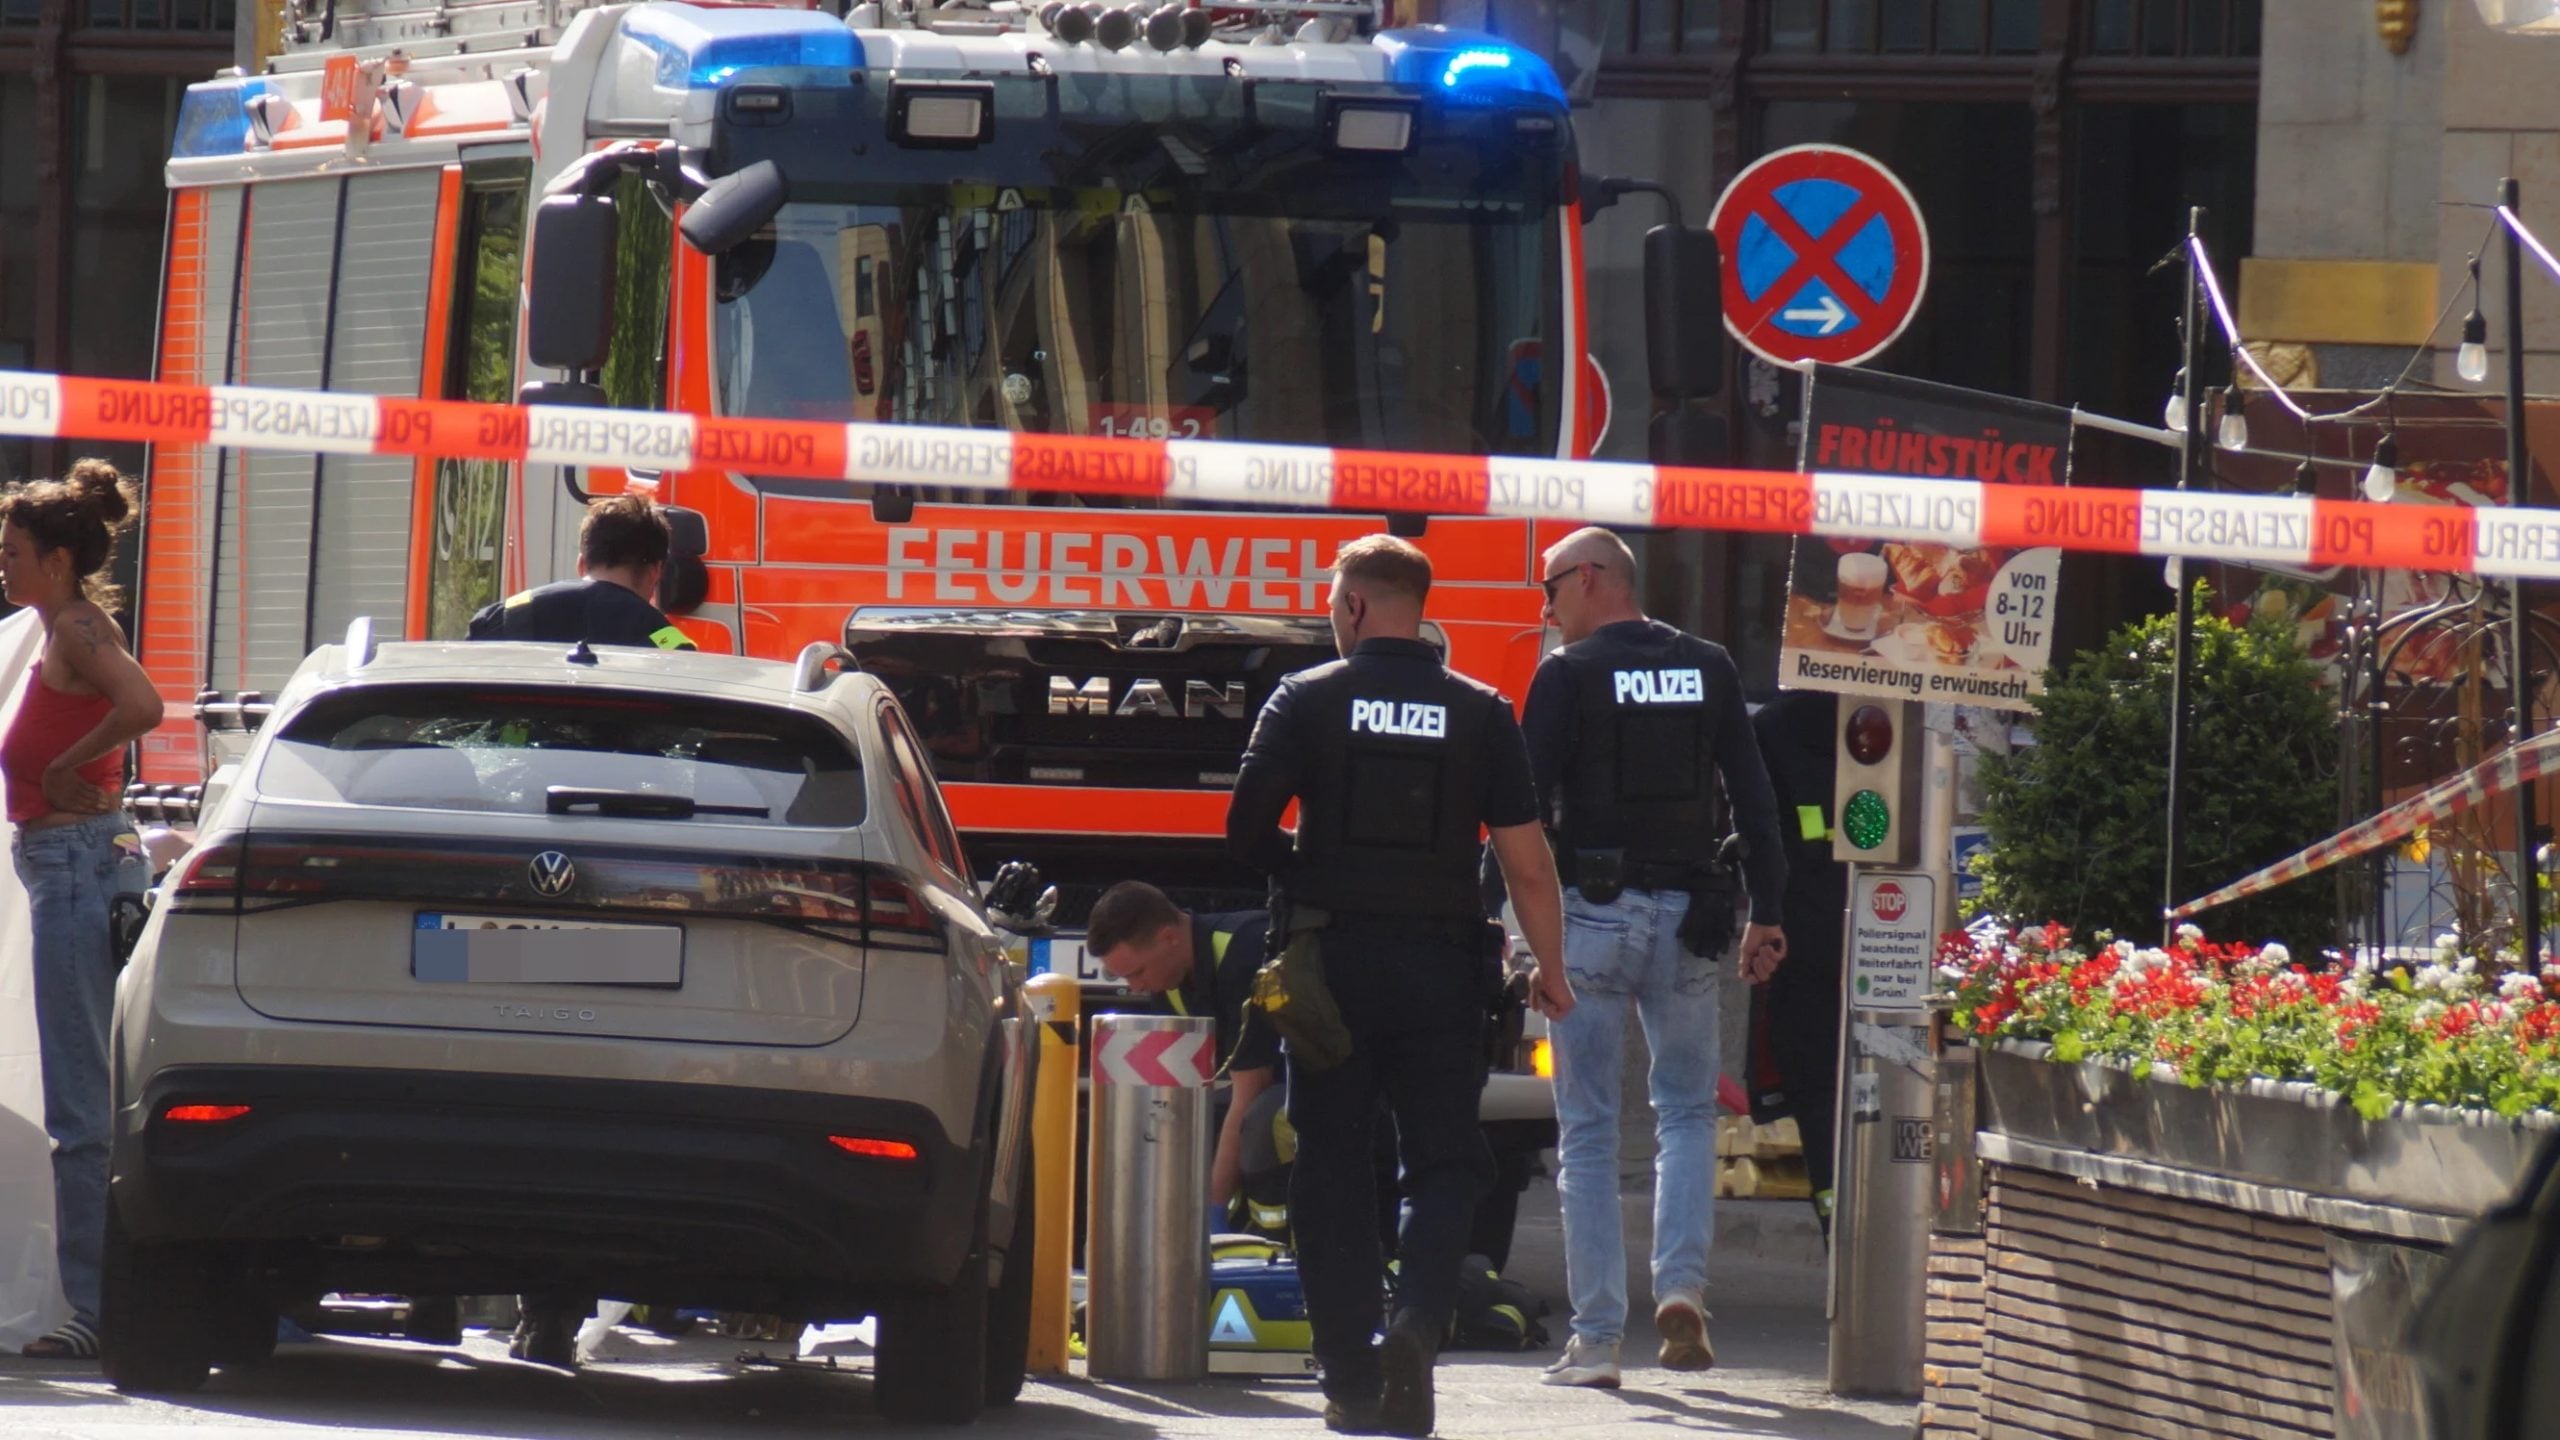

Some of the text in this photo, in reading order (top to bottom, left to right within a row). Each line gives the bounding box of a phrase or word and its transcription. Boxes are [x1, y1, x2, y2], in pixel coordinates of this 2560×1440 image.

[1101, 416, 1200, 441] 1-49-2
[1816, 417, 2058, 484] FRÜHSTÜCK
[886, 526, 1335, 610] FEUERWEH
[2010, 571, 2046, 590] von
[1996, 593, 2045, 619] 8-12
[2004, 621, 2042, 647] Uhr
[1614, 668, 1704, 704] POLIZEI
[1797, 654, 2028, 699] Reservierung erwünscht
[1048, 675, 1246, 719] MAN
[1351, 698, 1447, 739] POLIZEI
[1873, 892, 1905, 911] STOP
[1860, 942, 1920, 955] beachten!
[1857, 958, 1923, 969] Weiterfahrt
[1873, 973, 1917, 985] nur bei
[1872, 986, 1907, 998] Grün!
[493, 1005, 596, 1022] TAIGO
